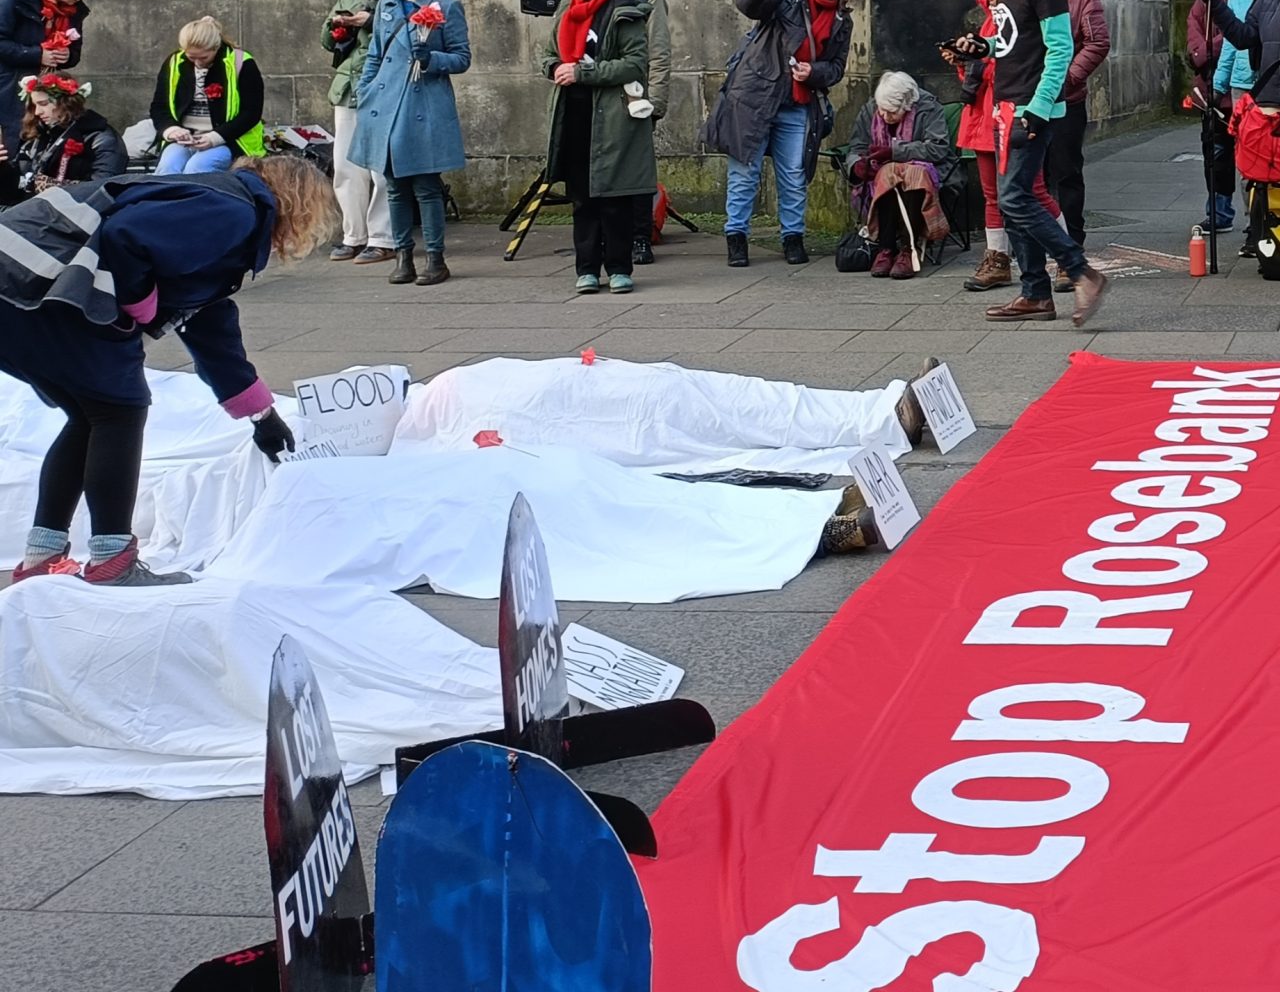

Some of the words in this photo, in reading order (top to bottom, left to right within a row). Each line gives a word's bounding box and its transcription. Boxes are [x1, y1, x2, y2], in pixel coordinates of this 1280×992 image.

[297, 371, 395, 416] FLOOD
[854, 451, 900, 508] WAR
[511, 535, 542, 630] LOST
[515, 616, 558, 734] HOMES
[563, 636, 618, 694] MASS
[281, 681, 322, 801] LOST
[278, 780, 355, 966] FUTURES
[737, 682, 1191, 992] Stop
